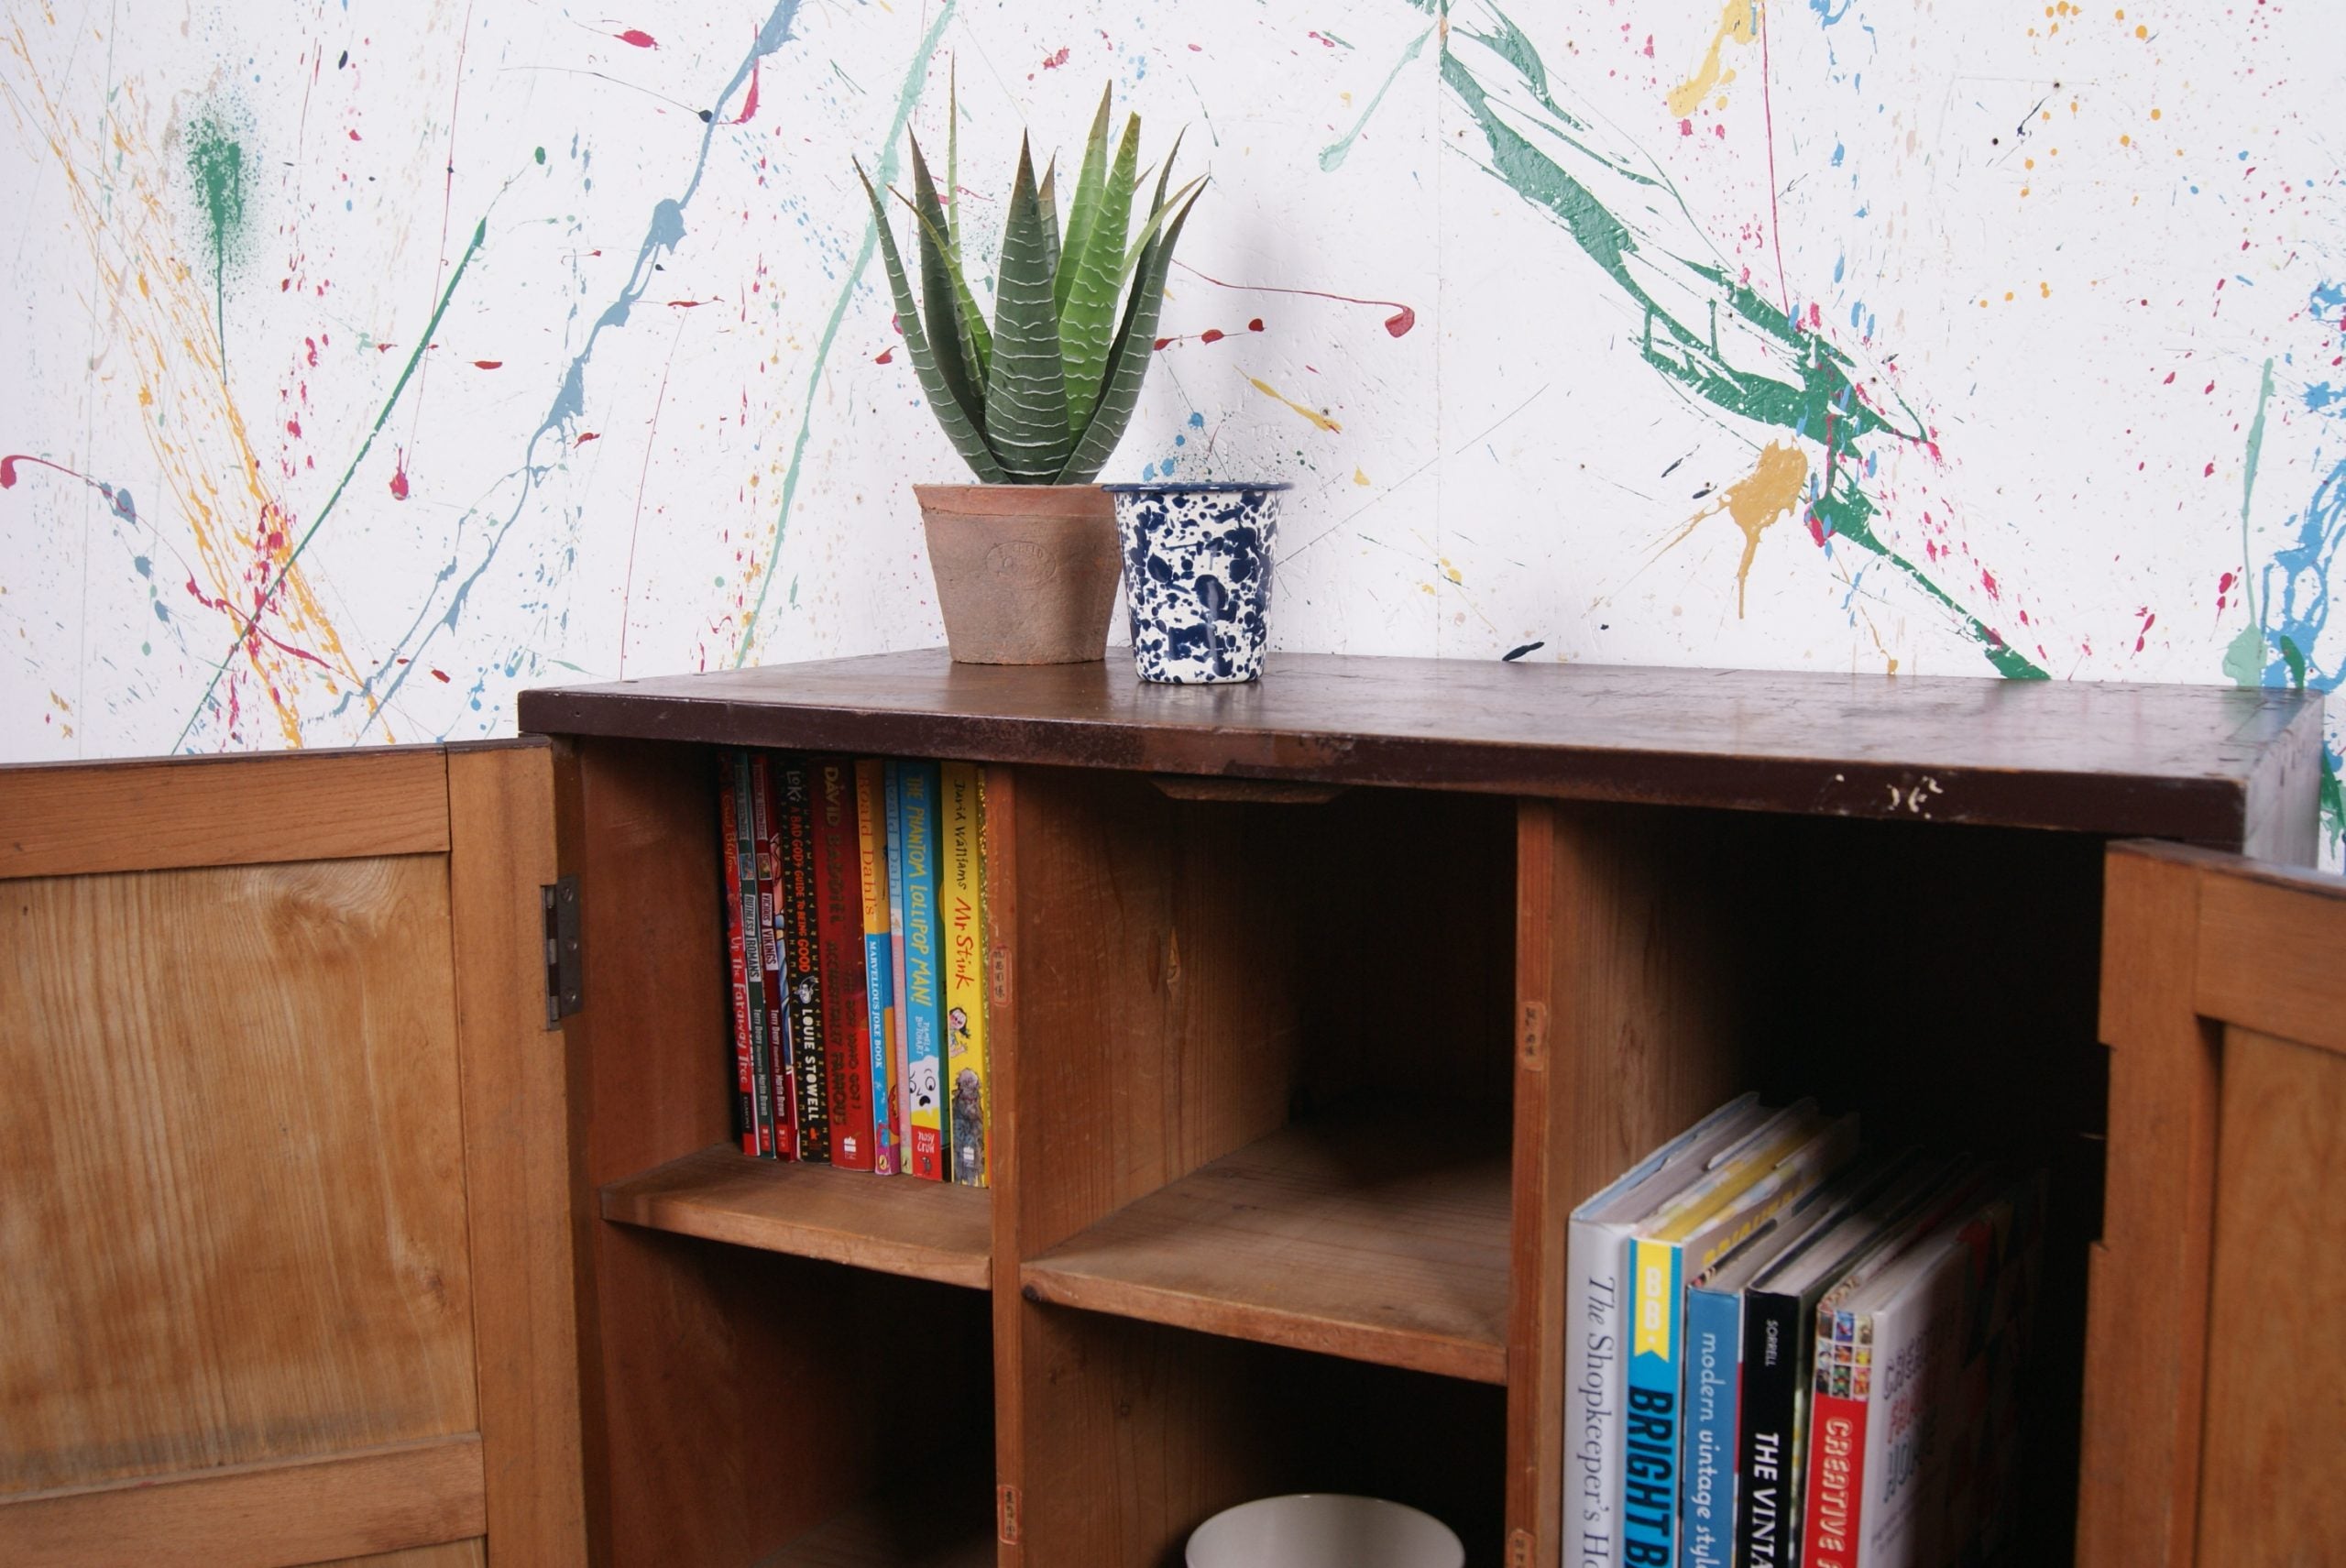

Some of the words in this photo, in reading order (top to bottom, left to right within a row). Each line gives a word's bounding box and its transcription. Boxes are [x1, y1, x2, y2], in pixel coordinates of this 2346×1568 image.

[824, 767, 841, 827] DAVID
[859, 776, 872, 837] Roald
[905, 777, 924, 799] THE
[953, 779, 966, 821] David
[790, 815, 801, 837] BAD
[906, 806, 927, 879] PHANTOM
[861, 850, 879, 916] Dahl's
[888, 846, 901, 898] Dahl
[954, 826, 970, 891] Walliams
[762, 894, 771, 921] VICIOUS
[794, 870, 805, 897] GUIDE
[745, 895, 755, 933] RUTHLESS
[796, 910, 806, 936] BEING
[909, 884, 930, 956] LOLLIPOP
[954, 896, 971, 931] Mr
[746, 939, 759, 978] ROMANS
[762, 930, 776, 966] VIKINGS
[797, 938, 811, 973] GOOD
[955, 935, 975, 990] Stink
[869, 940, 882, 1010] MARVELLOUS
[910, 957, 933, 1007] MAN!
[733, 982, 750, 1049] Faraway
[801, 1008, 816, 1050] LOUIE
[872, 1010, 882, 1037] JOKE
[922, 1022, 931, 1052] PAMELA
[739, 1052, 751, 1085] Tree
[873, 1038, 883, 1069] BOOK
[804, 1055, 819, 1122] STOWELL
[1587, 1276, 1616, 1325] The
[1763, 1319, 1779, 1367] SORRELL
[1700, 1332, 1727, 1422] modern
[1576, 1332, 1615, 1522] Shopkeeper's
[1626, 1386, 1674, 1537] BRIGHT
[1690, 1429, 1722, 1519] vintage
[1753, 1431, 1780, 1482] THE
[1817, 1418, 1853, 1552] CREATIVE
[1625, 1538, 1669, 1568] B
